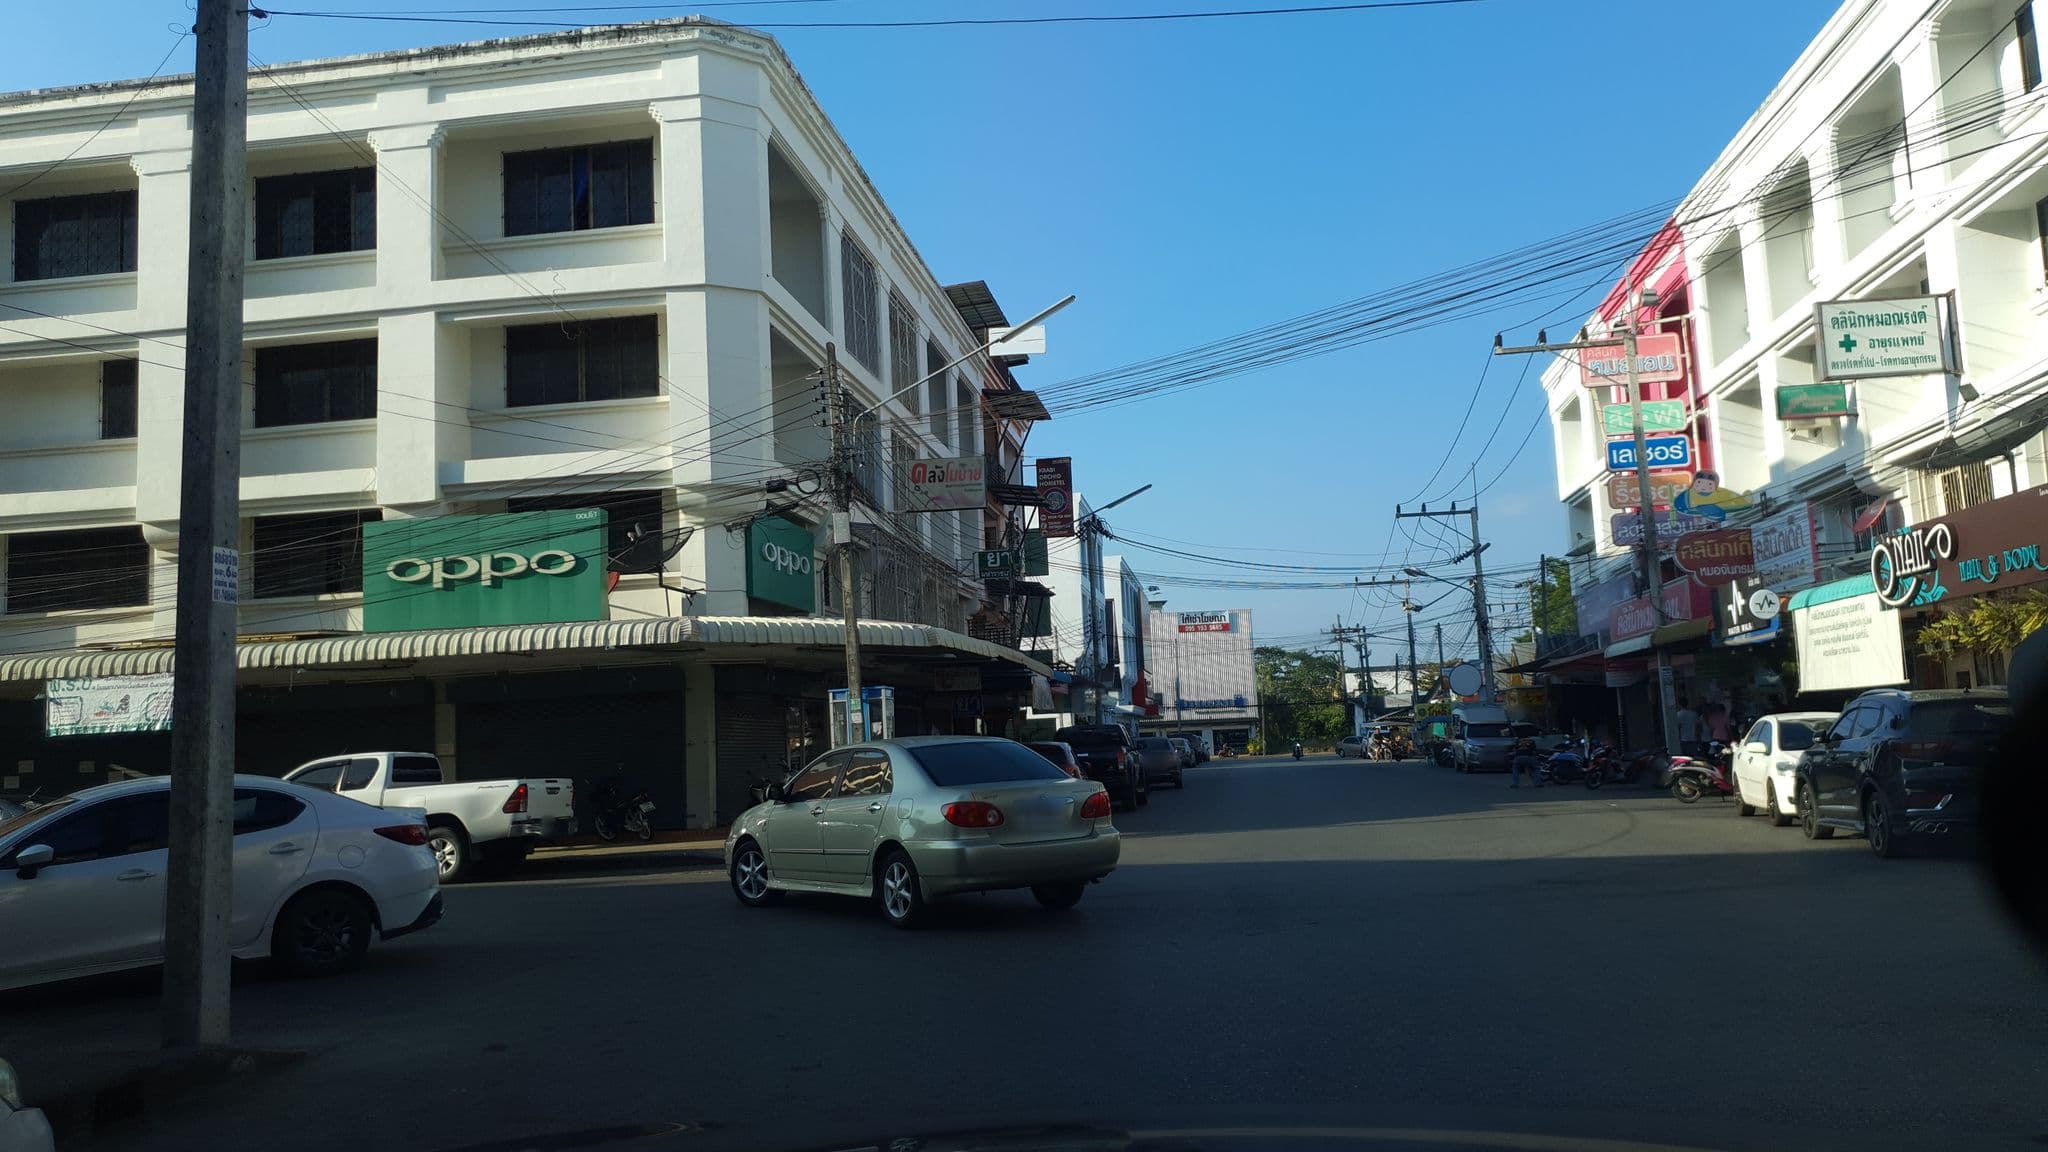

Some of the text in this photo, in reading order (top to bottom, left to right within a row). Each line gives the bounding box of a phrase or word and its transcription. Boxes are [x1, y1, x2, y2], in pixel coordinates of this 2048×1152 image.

[1830, 305, 1929, 330] คลินิกหมอณรงค์
[1868, 331, 1927, 353] อายุรแพทย์
